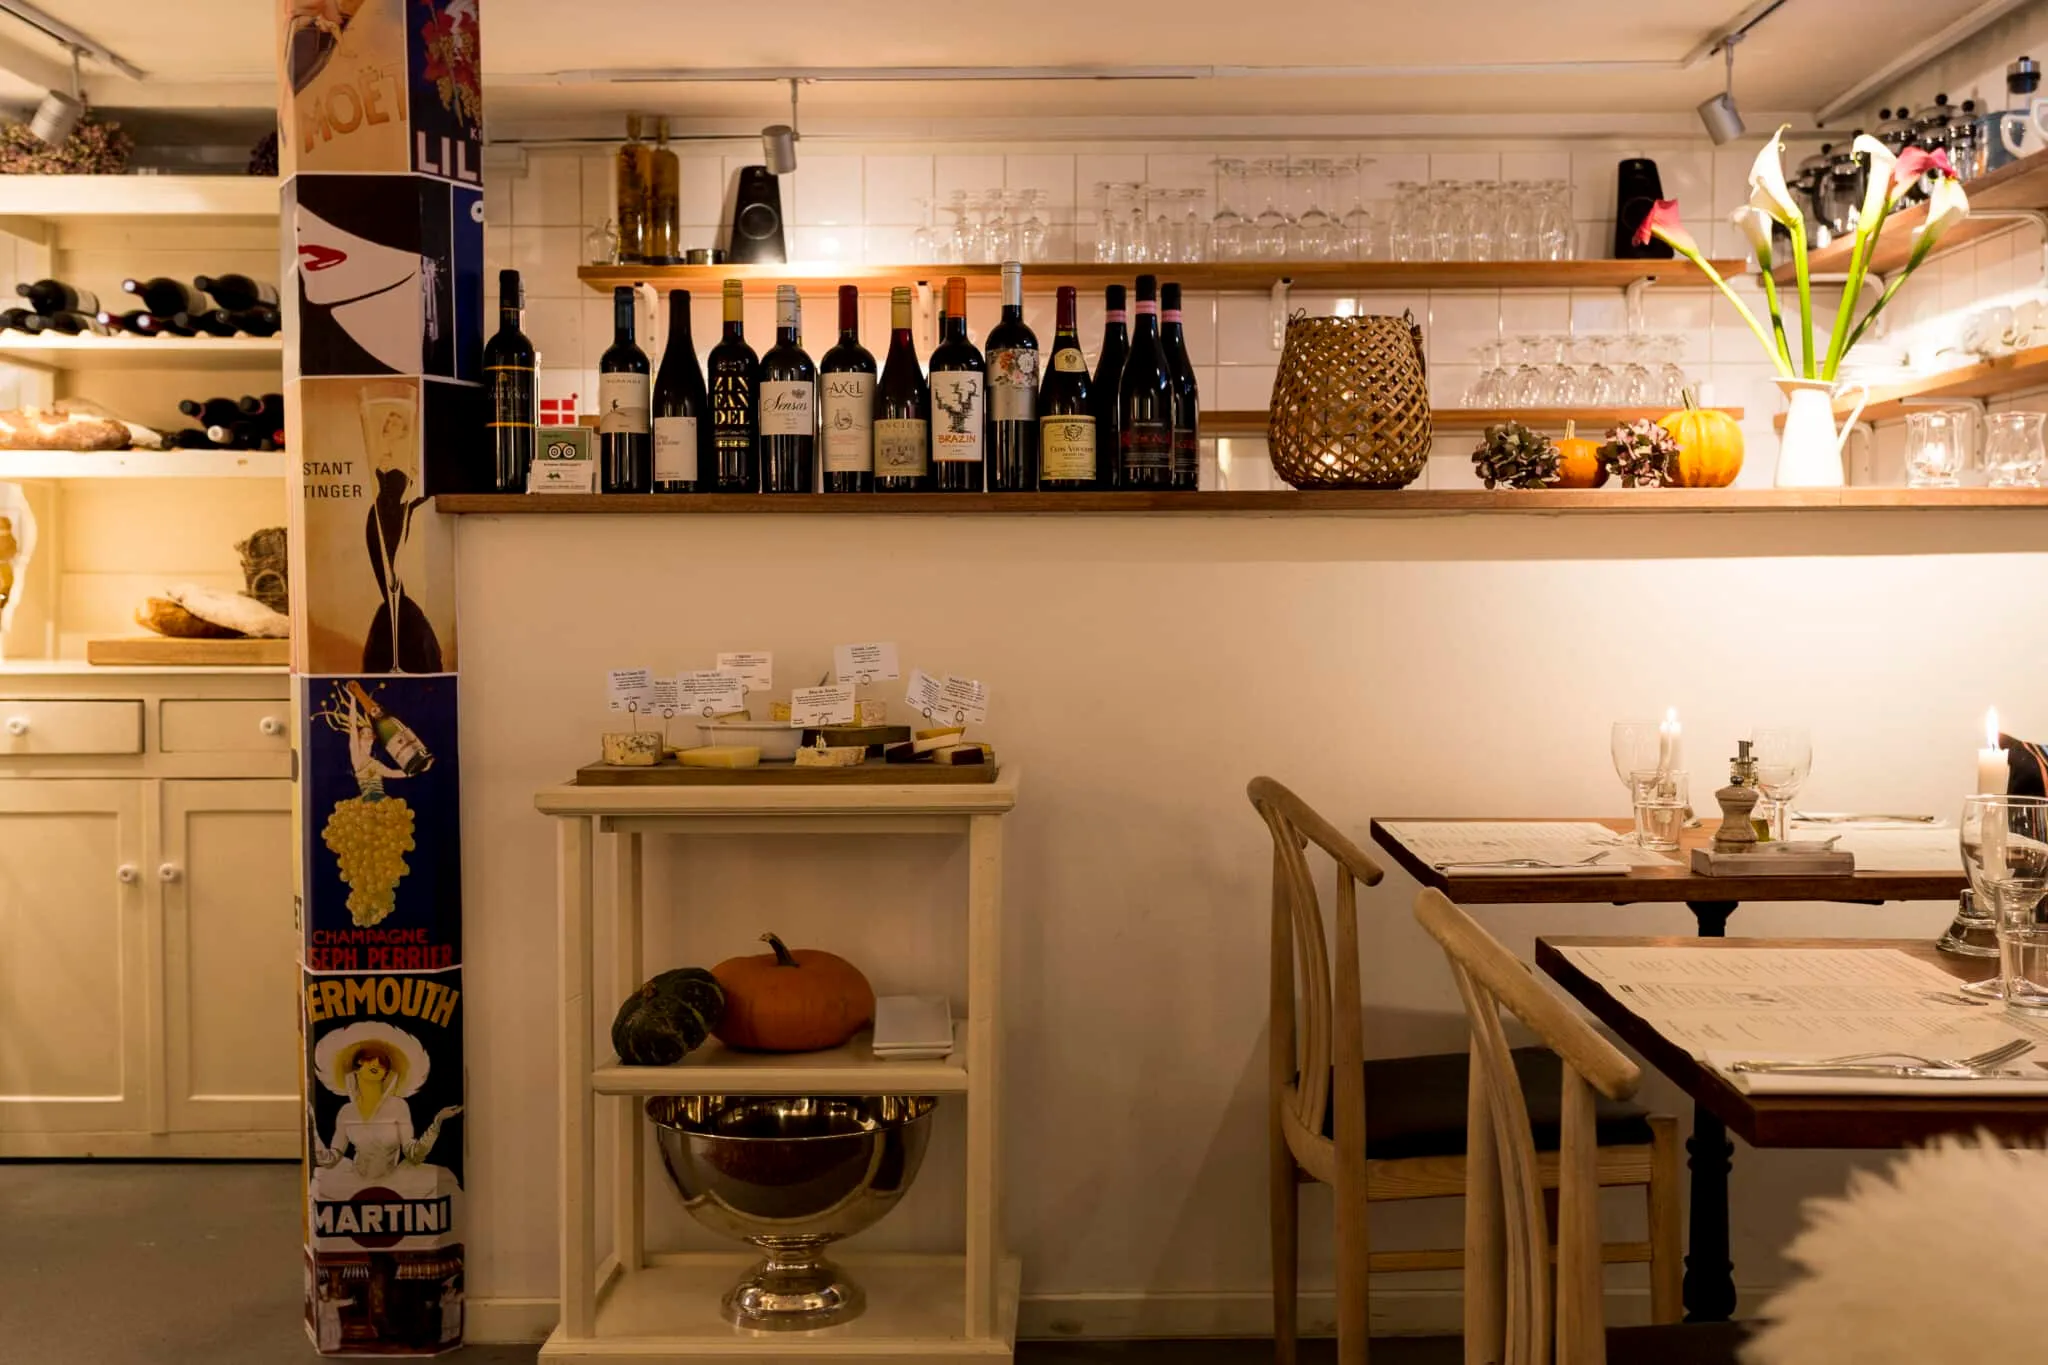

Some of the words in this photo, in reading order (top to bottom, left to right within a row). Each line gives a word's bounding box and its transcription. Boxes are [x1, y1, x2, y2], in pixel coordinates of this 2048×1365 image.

[417, 131, 477, 182] LIL
[828, 381, 863, 398] AXEL
[714, 410, 750, 424] DEL
[303, 462, 353, 476] STANT
[313, 928, 429, 945] CHAMPAGNE
[368, 943, 453, 970] PERRIER
[314, 1200, 447, 1233] MARTINI
